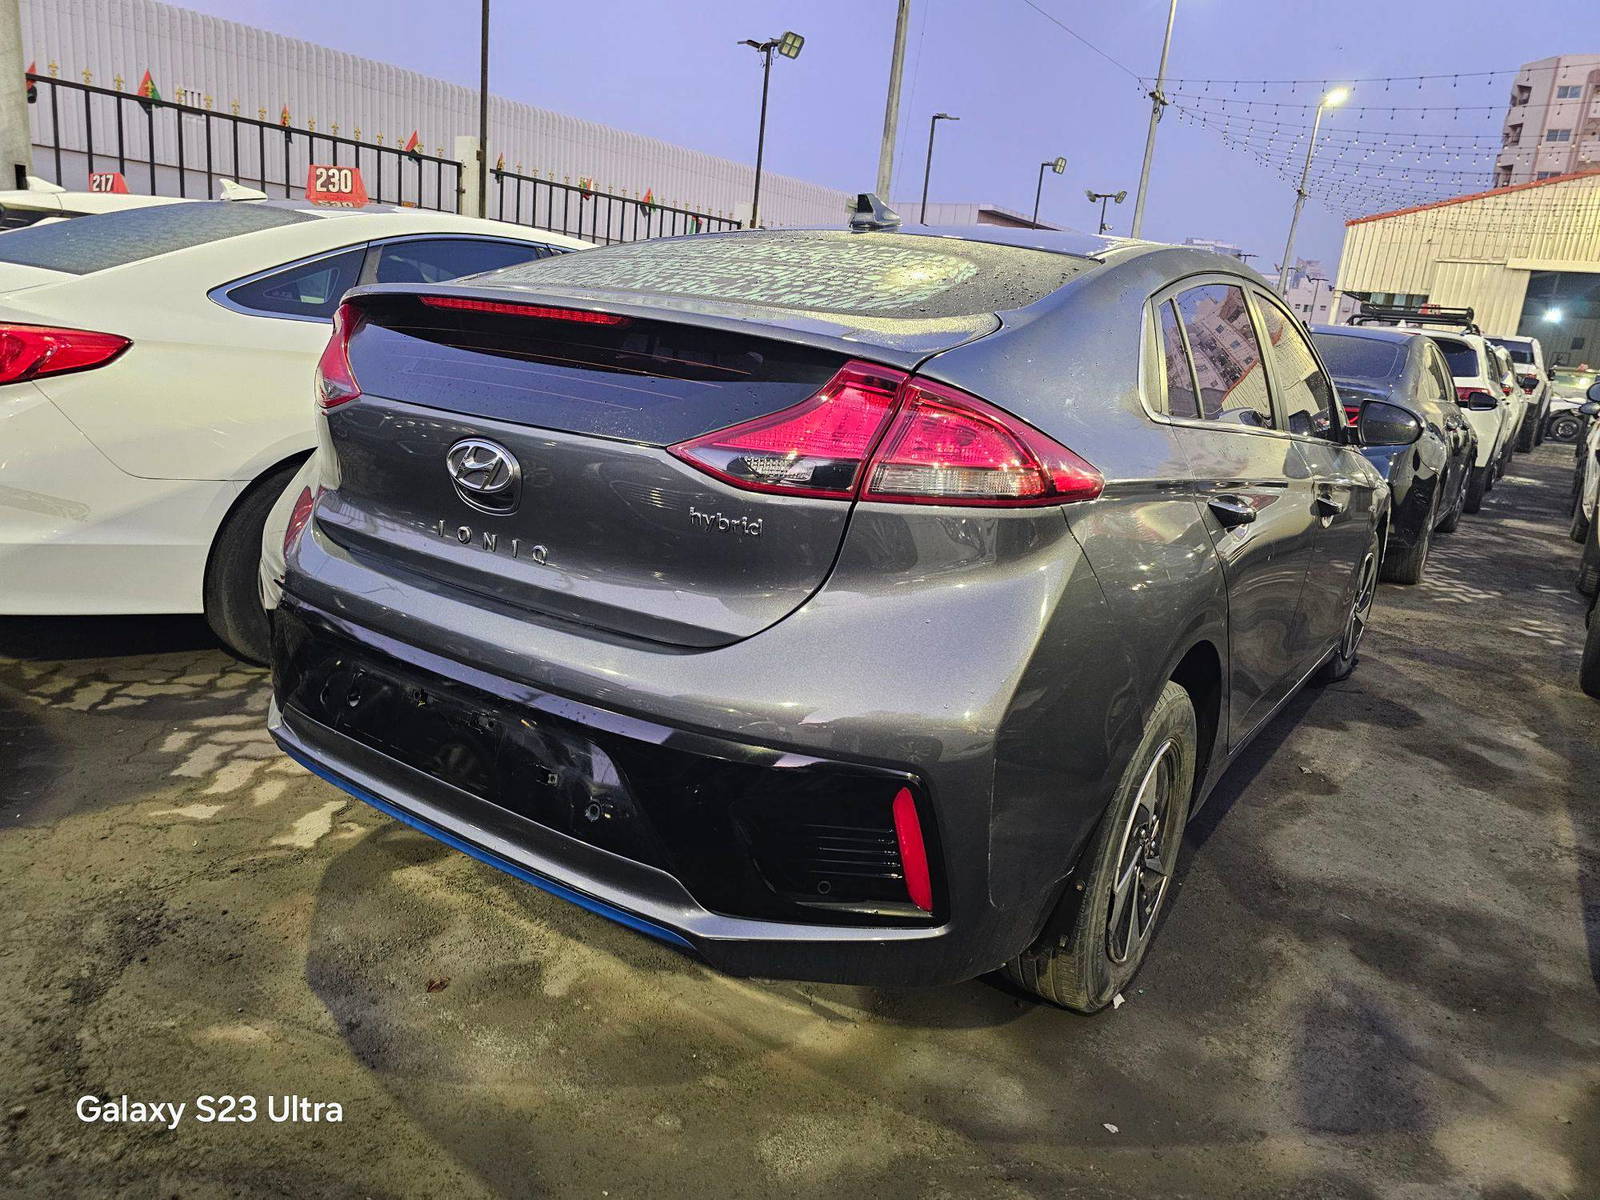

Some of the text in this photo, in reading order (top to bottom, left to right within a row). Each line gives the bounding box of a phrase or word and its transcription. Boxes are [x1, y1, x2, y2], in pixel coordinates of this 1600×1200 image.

[92, 174, 115, 192] 217
[315, 167, 353, 193] 230
[688, 506, 764, 537] hybrid
[437, 520, 549, 565] IONIQ
